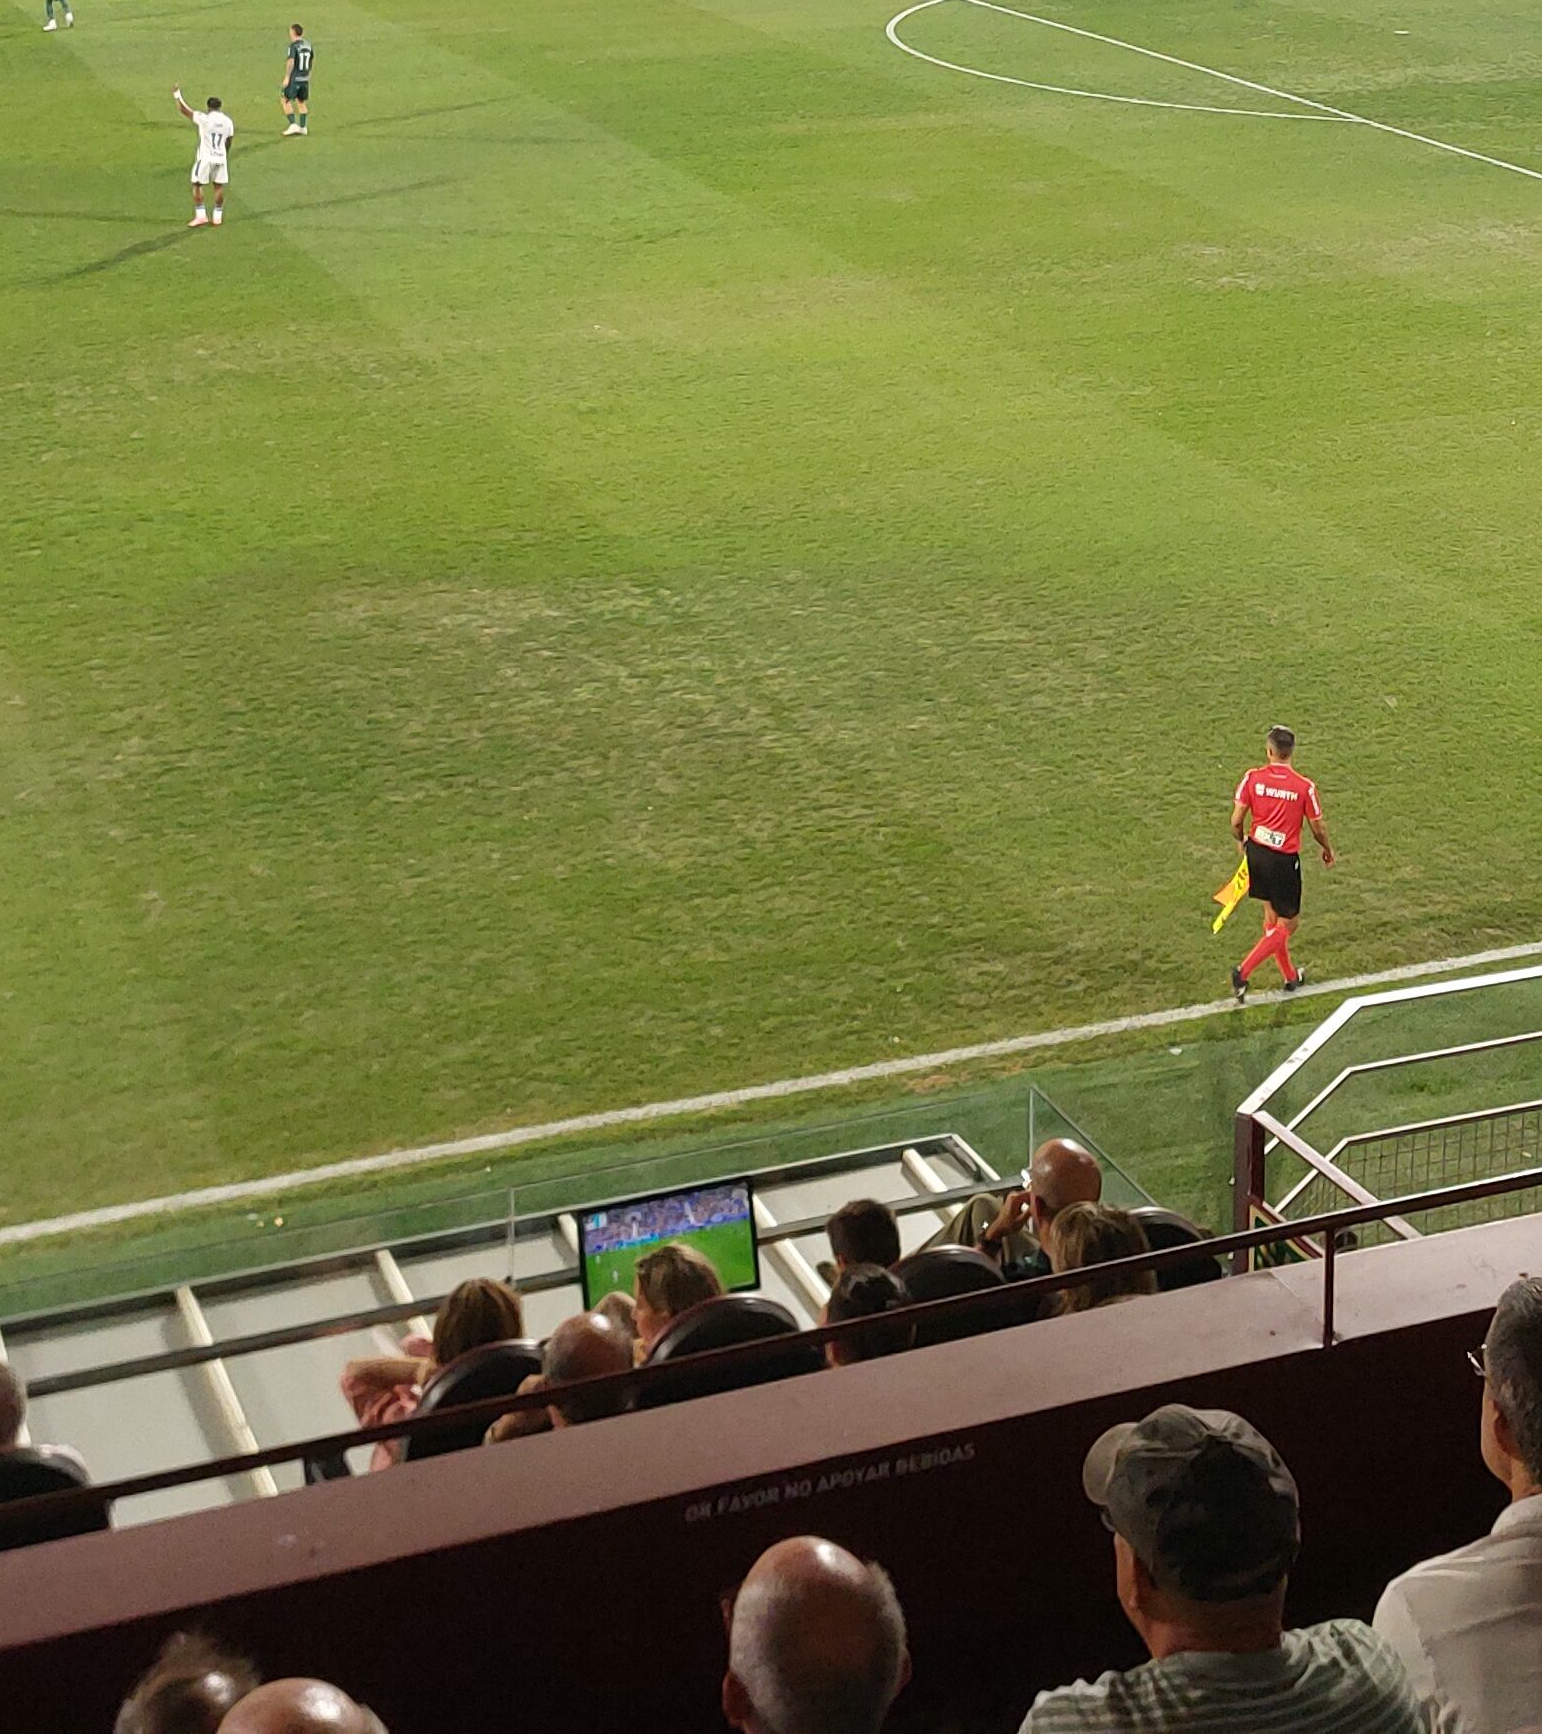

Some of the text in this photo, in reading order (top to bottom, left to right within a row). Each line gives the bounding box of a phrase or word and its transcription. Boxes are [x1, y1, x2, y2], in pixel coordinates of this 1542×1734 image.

[716, 1487, 780, 1515] FAVOR
[783, 1480, 813, 1499] NO
[816, 1462, 891, 1493] APOYAR
[895, 1442, 976, 1476] BEBIDAS
